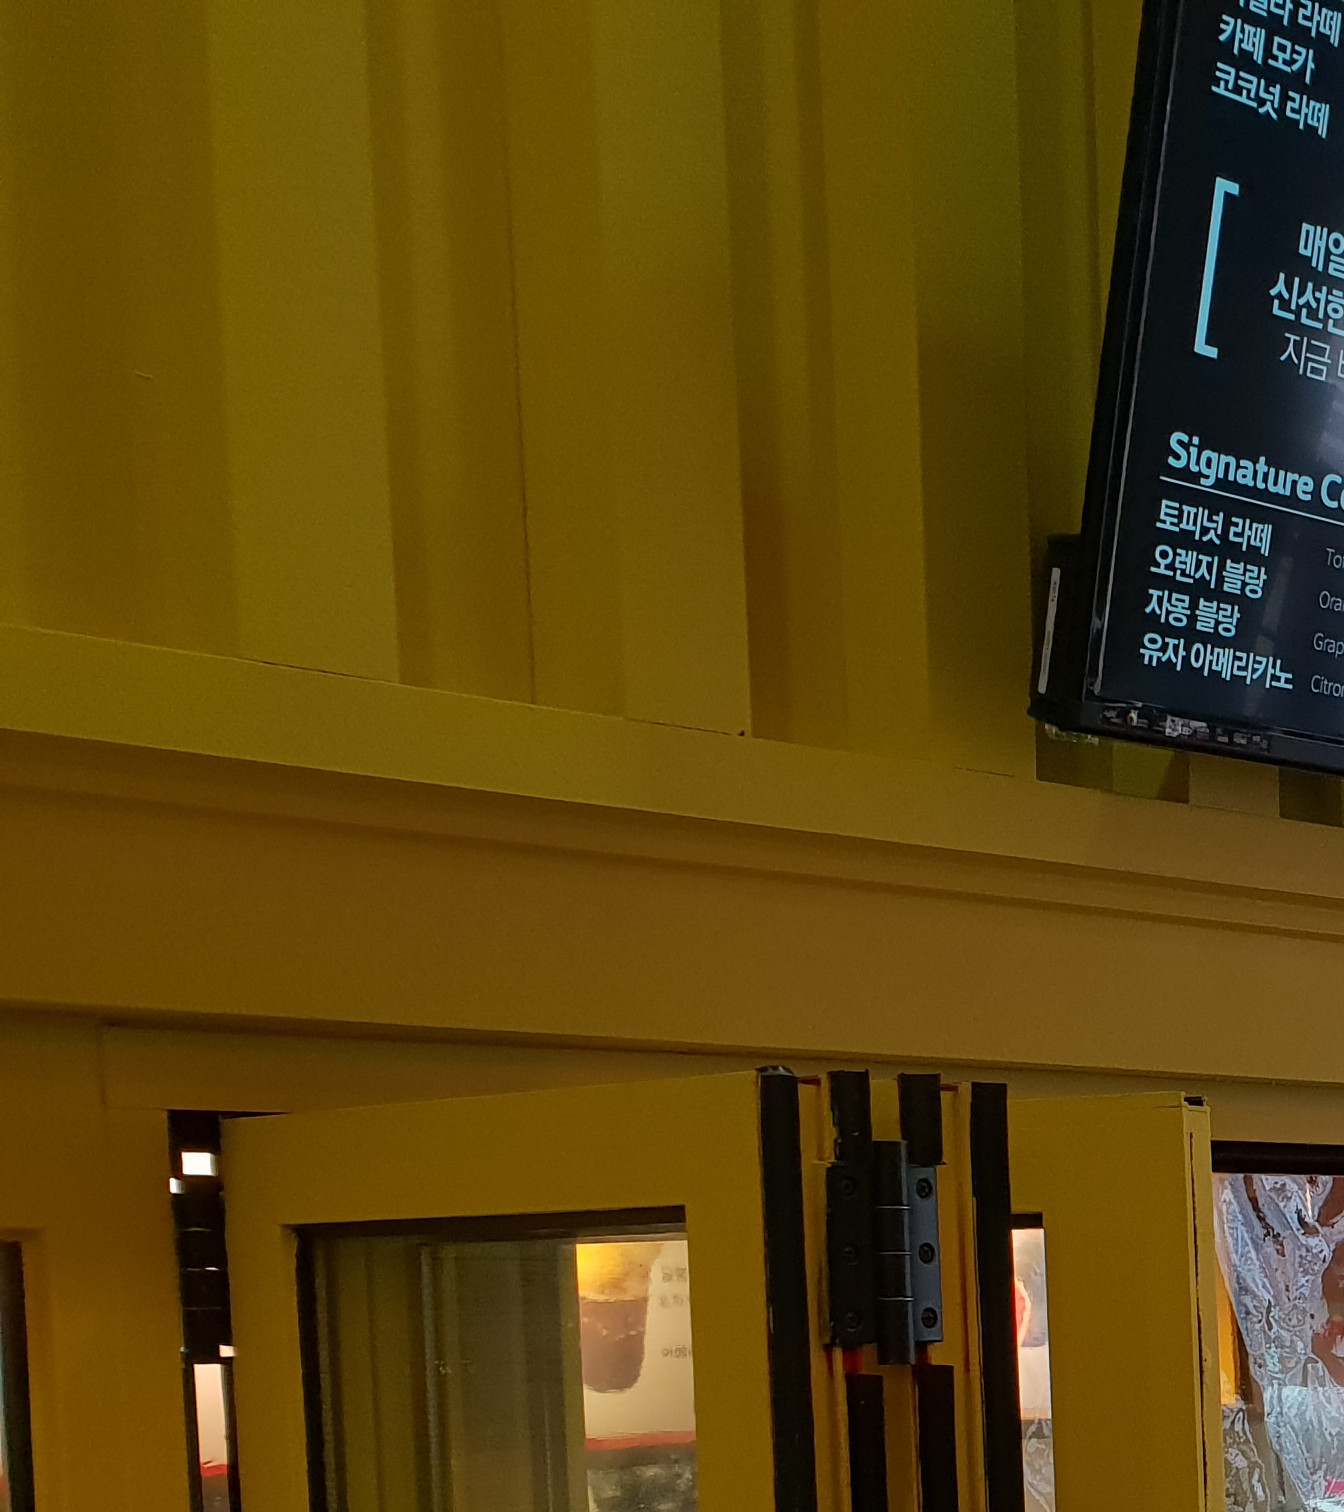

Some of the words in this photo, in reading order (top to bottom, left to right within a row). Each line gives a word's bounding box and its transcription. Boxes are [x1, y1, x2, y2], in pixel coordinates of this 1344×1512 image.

[1217, 14, 1266, 65] 카페
[1267, 36, 1316, 85] 모카
[1297, 0, 1342, 48] 라떼
[1211, 61, 1281, 121] 코코넛
[1285, 90, 1330, 139] 라떼
[1280, 332, 1331, 382] 지금
[1167, 431, 1314, 501] Signature
[1155, 498, 1224, 545] 토피넛
[1228, 515, 1273, 557] 라떼
[1150, 544, 1219, 589] 오렌지
[1222, 558, 1268, 599] 블랑
[1144, 588, 1191, 627] 자몽
[1195, 598, 1240, 637] 블랑
[1140, 633, 1186, 672] 유자
[1190, 642, 1294, 690] 아메리카노
